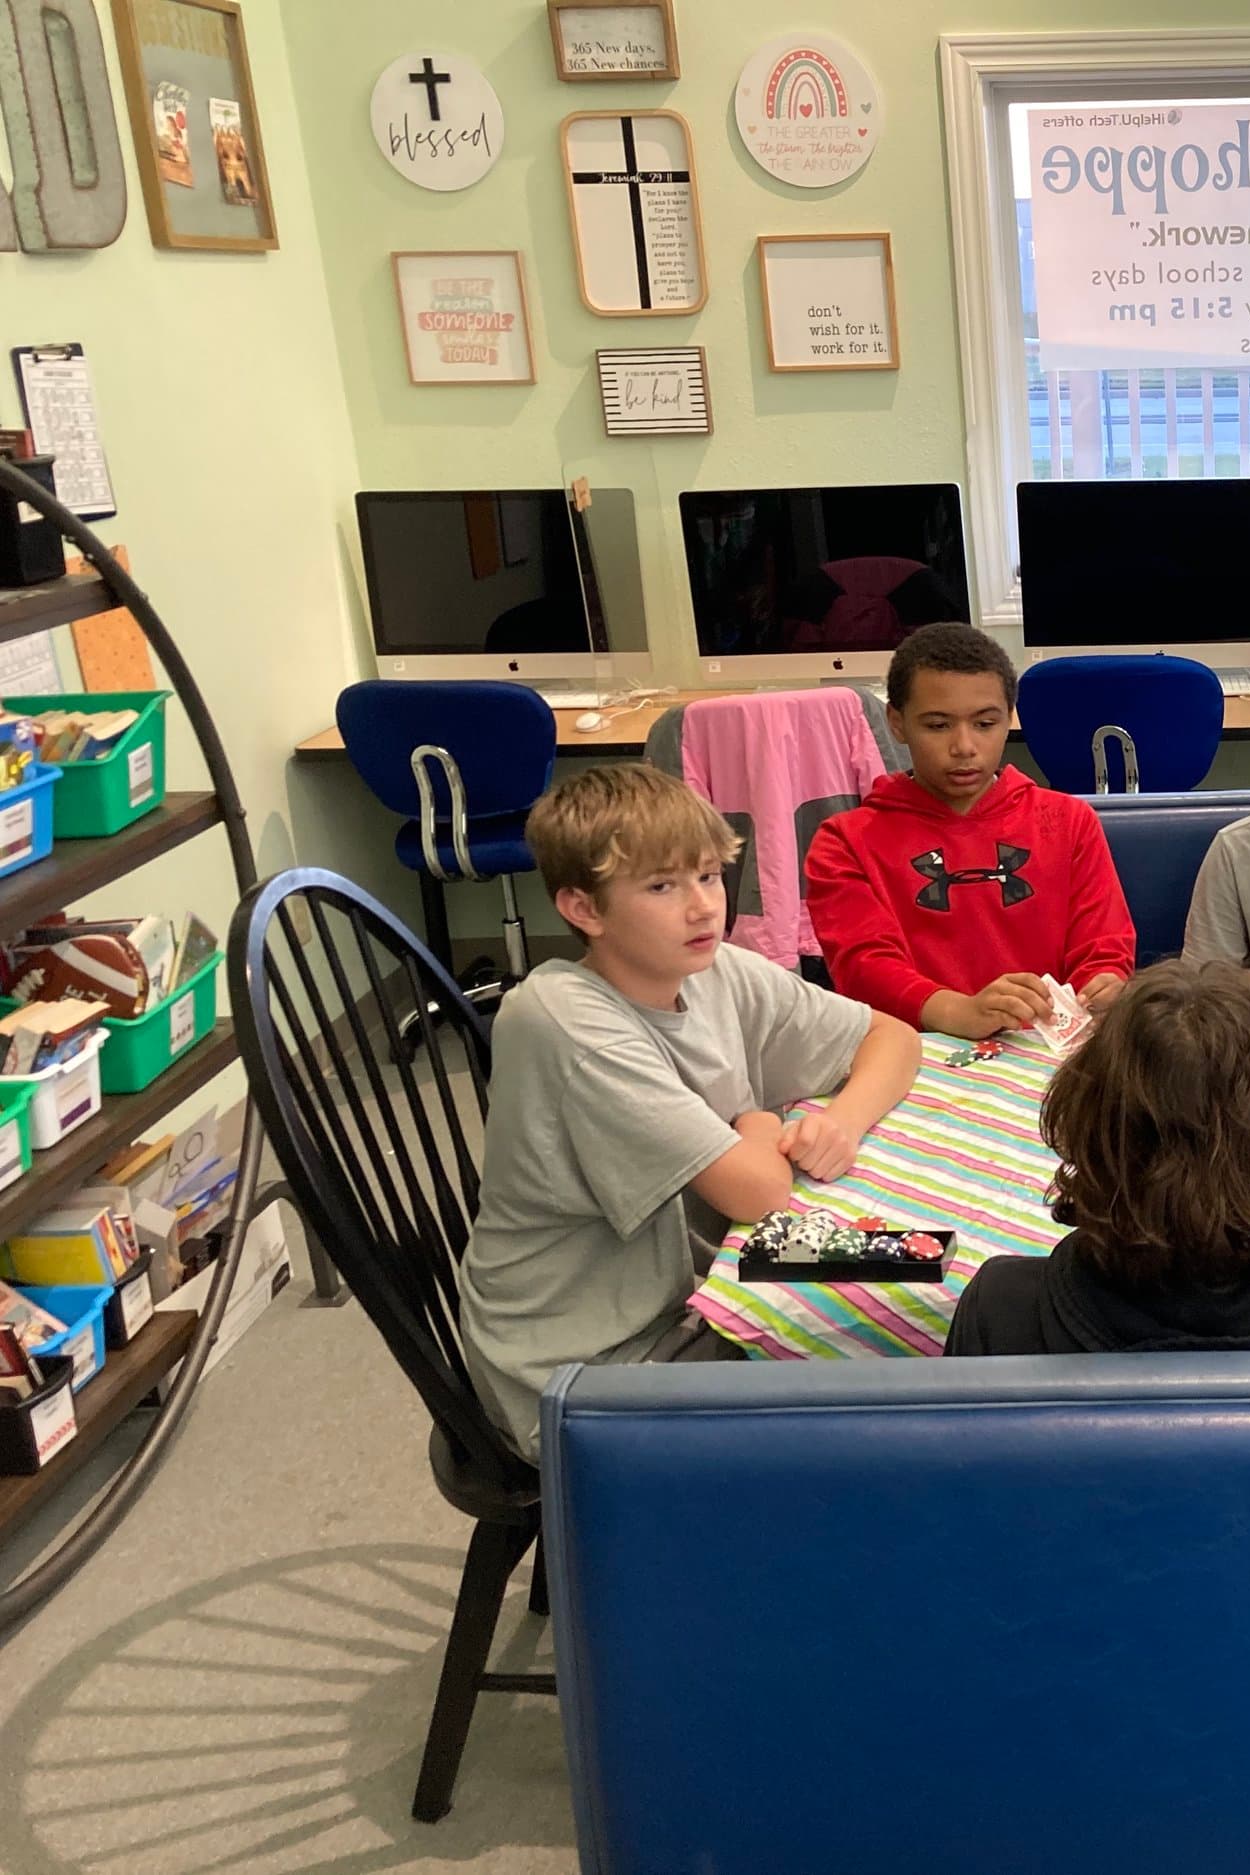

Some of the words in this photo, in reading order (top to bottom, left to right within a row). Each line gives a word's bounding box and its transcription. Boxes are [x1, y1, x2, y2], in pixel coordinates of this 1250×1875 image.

[571, 42, 593, 55] 365
[596, 41, 620, 54] New
[567, 58, 588, 71] 365
[592, 57, 617, 70] New
[388, 111, 492, 162] blessed
[767, 126, 792, 139] THE
[796, 126, 851, 139] GREATER
[767, 159, 792, 171] THE
[807, 304, 842, 318] don't
[809, 323, 841, 336] wish
[845, 322, 865, 336] for
[870, 322, 884, 335] it.
[446, 346, 491, 364] TODAY
[811, 341, 845, 355] work
[849, 341, 869, 354] for
[873, 341, 888, 353] it.
[625, 378, 647, 410] be
[652, 378, 683, 412] kind
